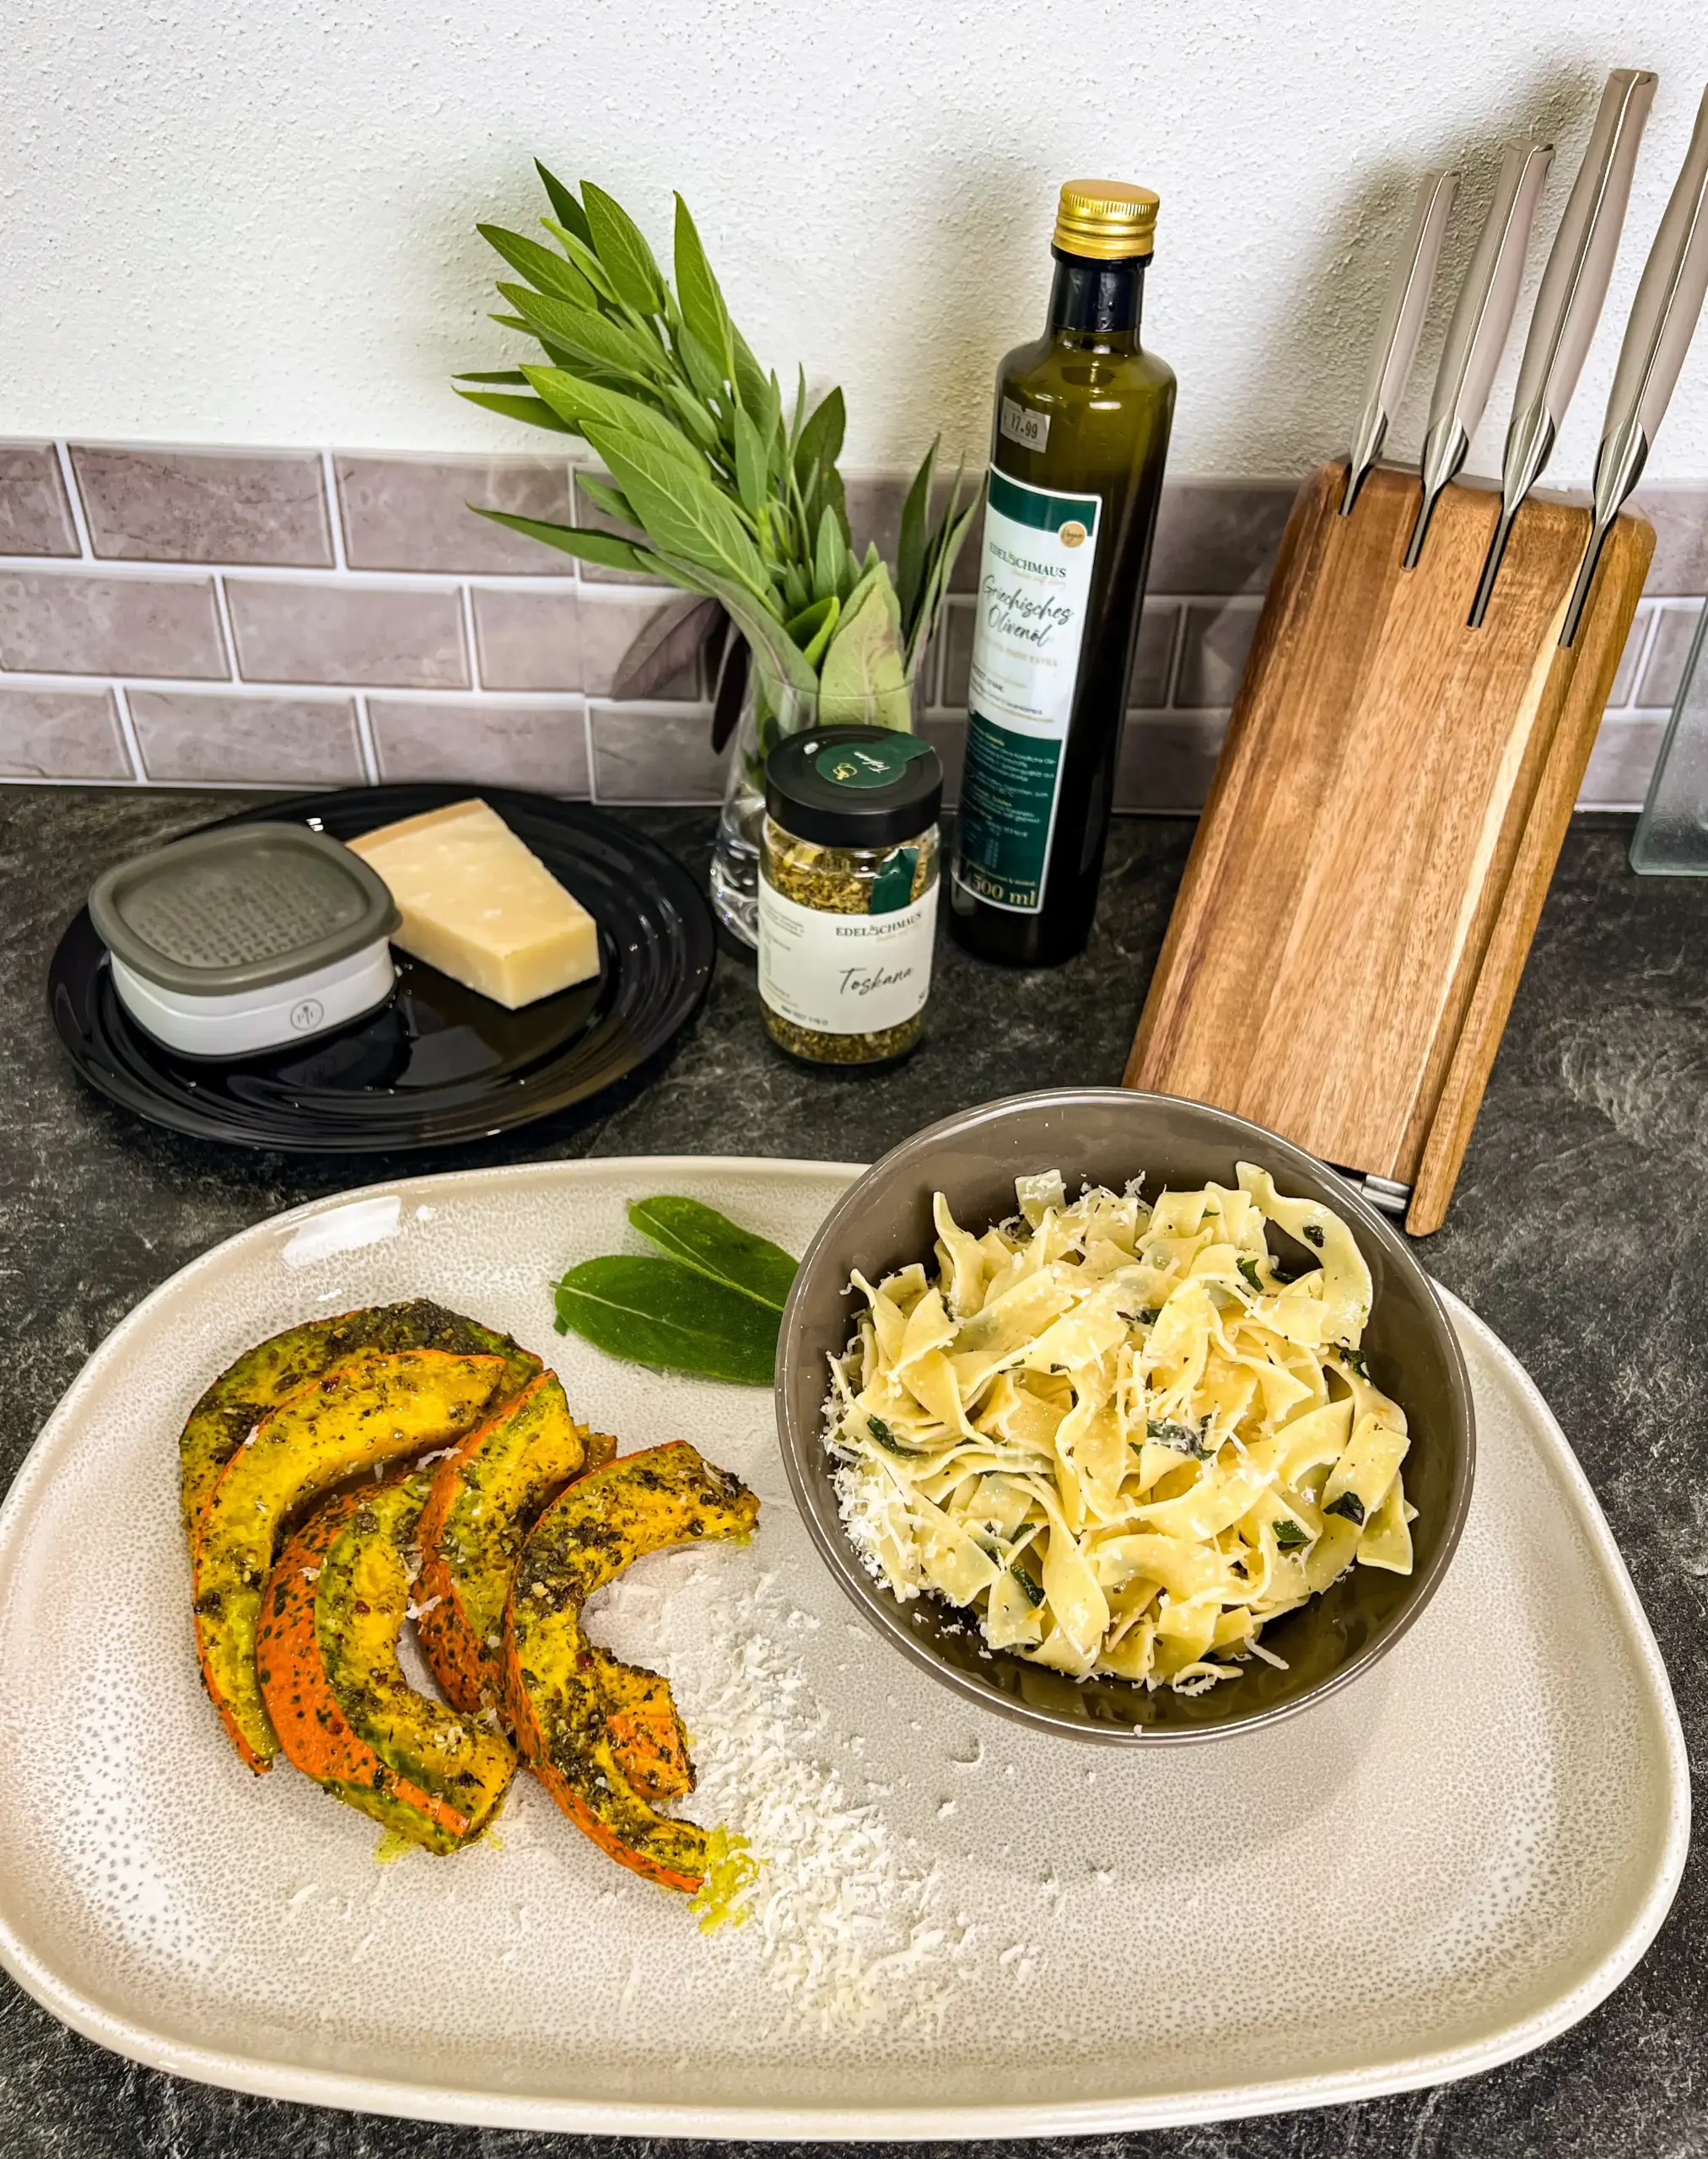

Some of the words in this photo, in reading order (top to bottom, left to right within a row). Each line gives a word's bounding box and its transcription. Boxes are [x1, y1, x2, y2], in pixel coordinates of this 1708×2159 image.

[972, 874, 1005, 901] 500
[1009, 890, 1037, 907] ml
[839, 967, 913, 996] Toskana
